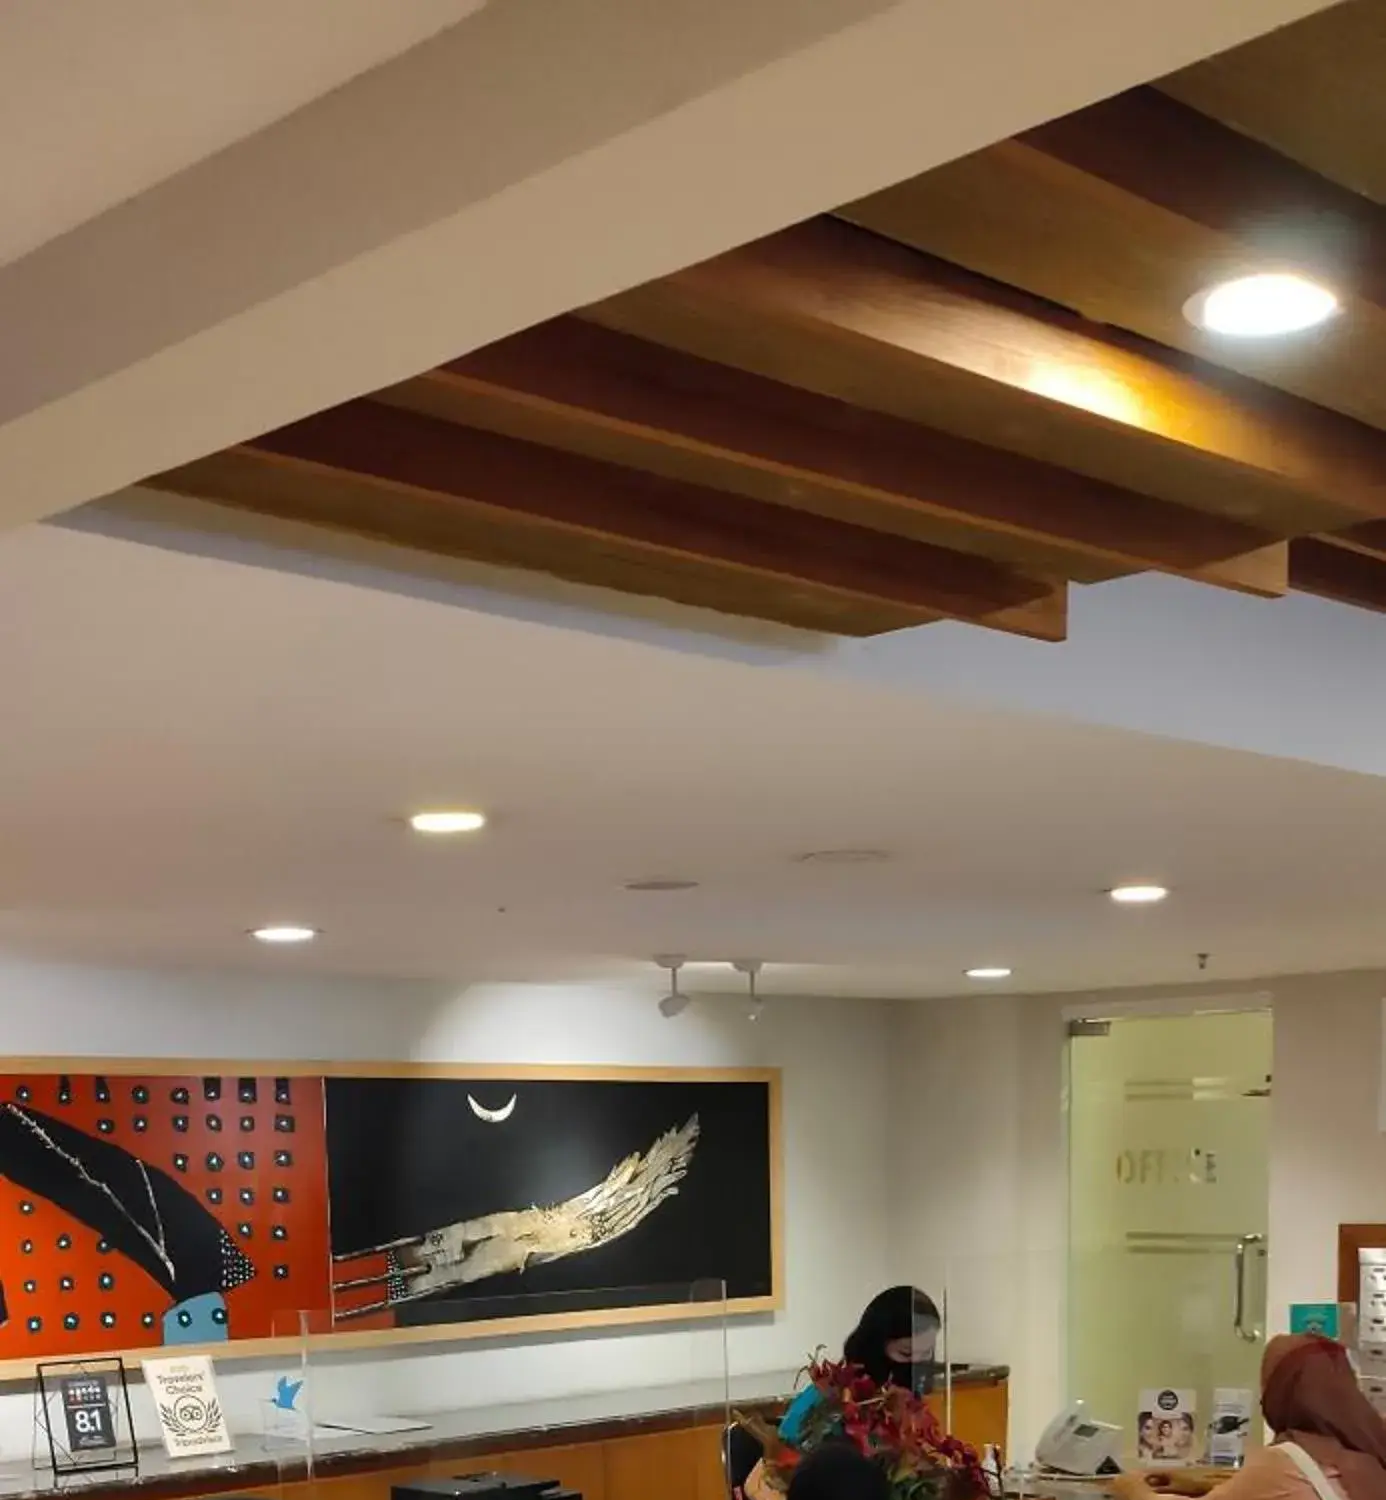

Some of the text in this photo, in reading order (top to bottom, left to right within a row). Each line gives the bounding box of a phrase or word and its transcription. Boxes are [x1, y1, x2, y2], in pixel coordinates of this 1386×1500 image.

[1116, 1148, 1217, 1185] OFFCE
[165, 1385, 203, 1395] Choice
[75, 1409, 102, 1433] 8.1
